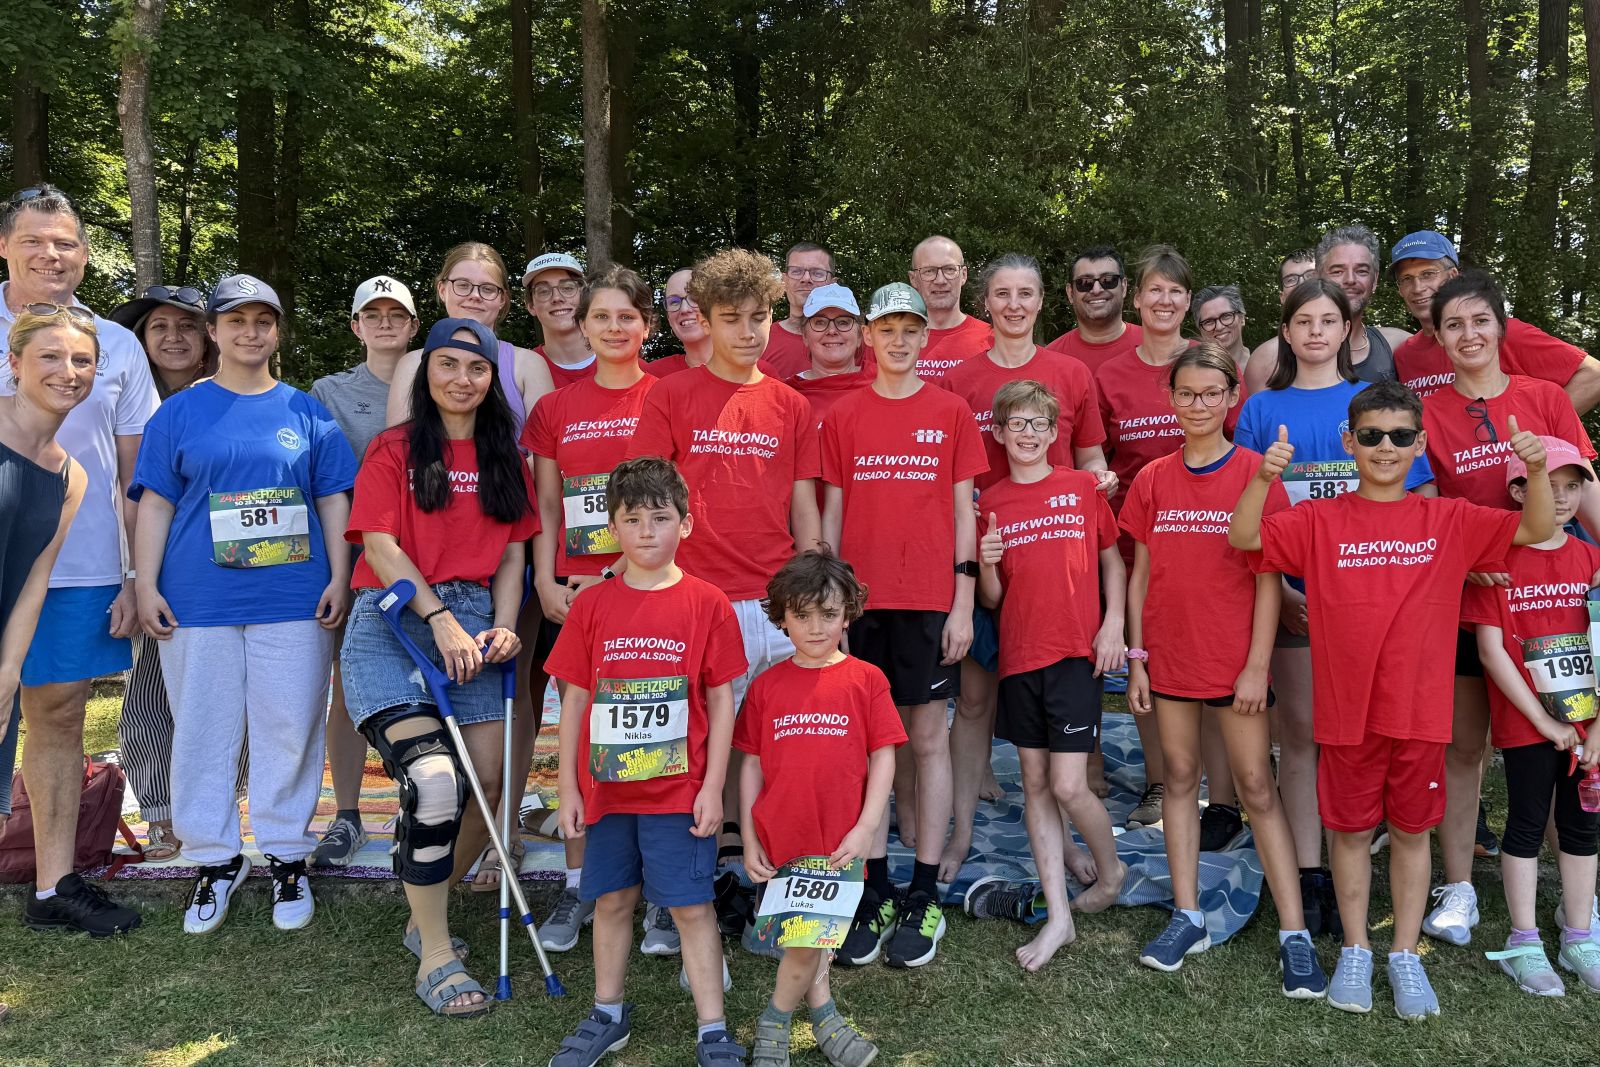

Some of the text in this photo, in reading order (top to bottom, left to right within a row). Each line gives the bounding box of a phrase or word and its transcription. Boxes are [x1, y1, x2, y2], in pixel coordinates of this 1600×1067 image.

[916, 360, 963, 368] EKWON
[1404, 372, 1456, 390] EKWOND
[566, 418, 640, 434] TAEKWOND
[1119, 414, 1178, 430] TAEKWON
[562, 429, 636, 444] MUSADO ALSDO
[692, 430, 778, 448] TAEKWONDO
[1120, 428, 1186, 442] MUSADO ALSD
[690, 444, 776, 459] MUSADO ALSDORF
[1453, 441, 1513, 462] TAEKWO
[1456, 456, 1501, 474] MUSADO
[584, 494, 608, 514] 58
[240, 507, 278, 528] 581
[996, 514, 1085, 536] TAEKWONDO
[1189, 524, 1229, 534] ALSDOR
[1338, 538, 1437, 556] TAEKWONDO
[1338, 556, 1387, 568] MUSADO
[1505, 582, 1590, 600] TAEKWOND
[1554, 598, 1587, 607] ALSD
[604, 638, 686, 652] TAEKWONDO
[639, 652, 682, 663] ALSDORF
[1544, 654, 1594, 679] 1992
[608, 704, 669, 729] 1579
[773, 713, 849, 730] TAEKWONDO
[805, 726, 848, 736] ALSDORF
[617, 747, 646, 762] WE'RE
[616, 760, 658, 778] TOGETHER
[785, 877, 839, 901] 1580
